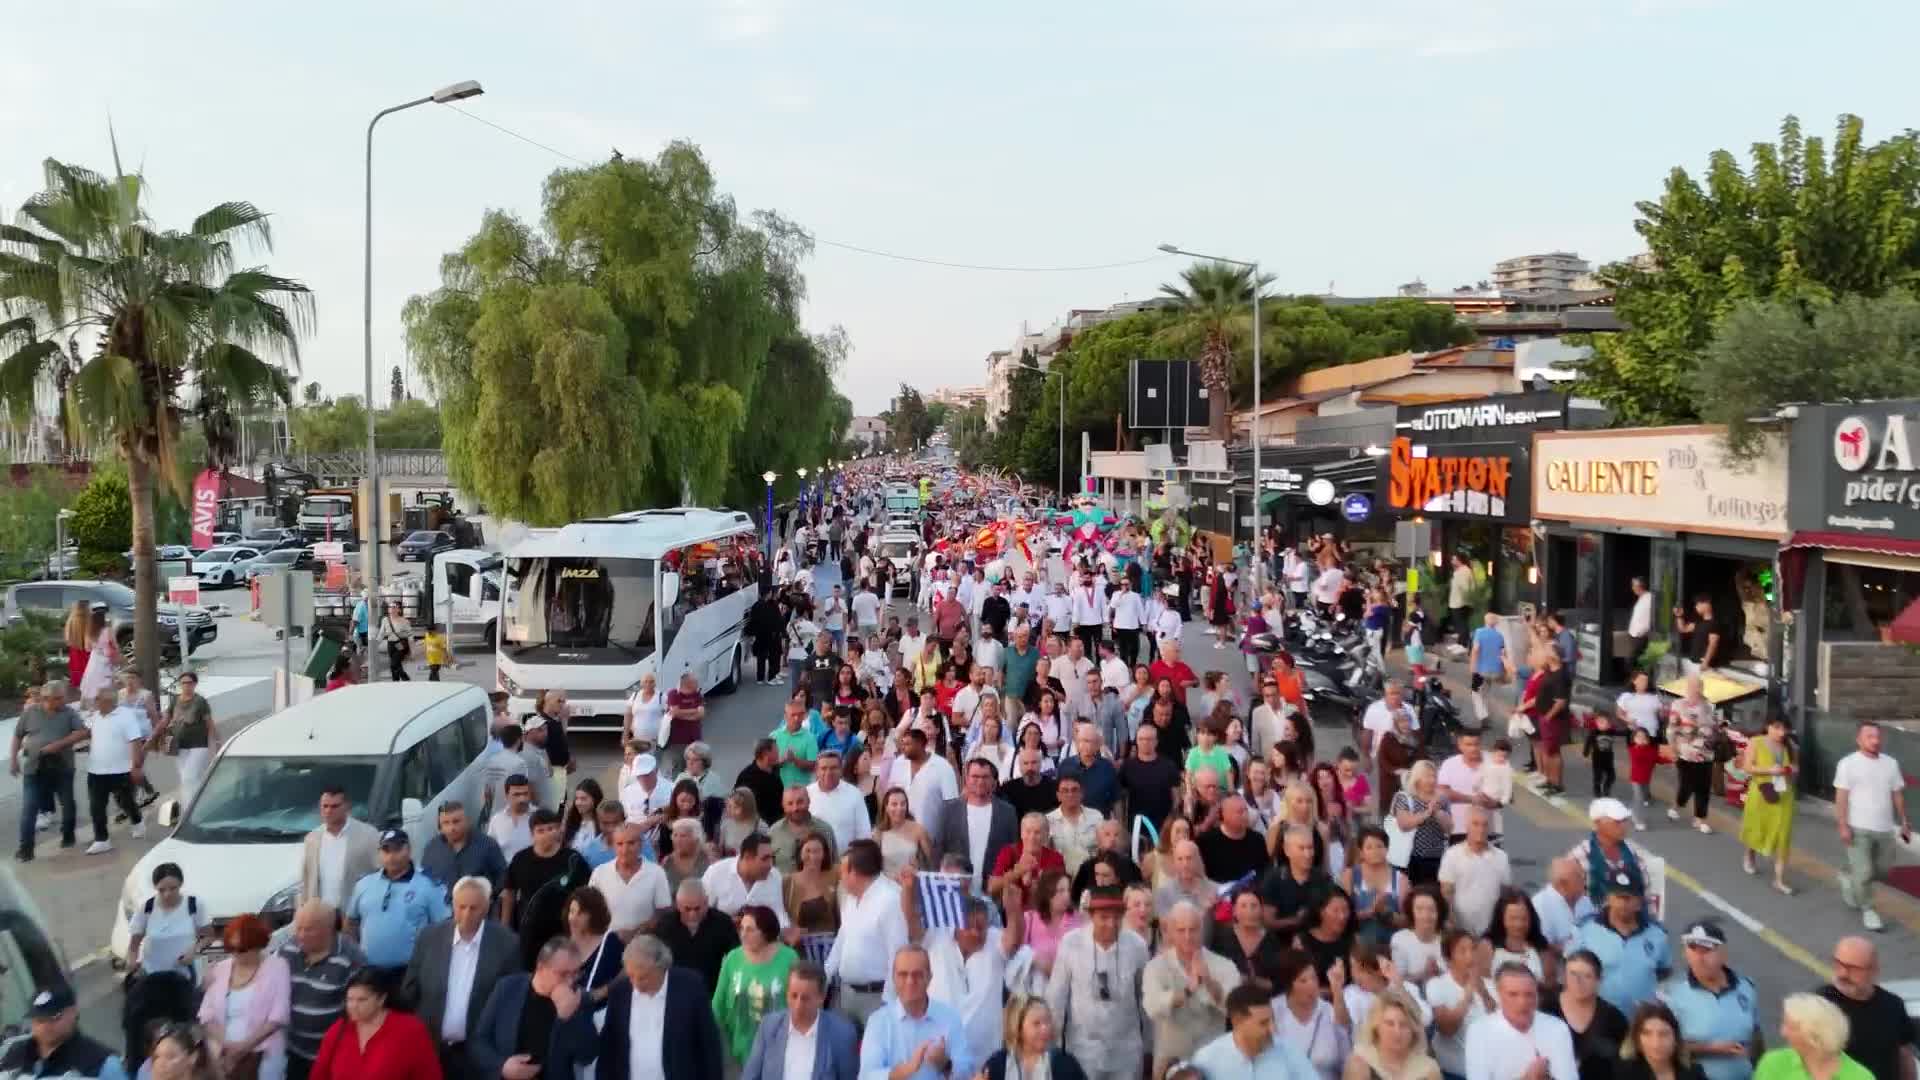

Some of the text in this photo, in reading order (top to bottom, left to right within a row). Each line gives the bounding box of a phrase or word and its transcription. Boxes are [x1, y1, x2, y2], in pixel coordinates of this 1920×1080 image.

[1874, 414, 1920, 471] A
[1389, 436, 1511, 510] STATION
[1546, 454, 1659, 496] CALIENTE
[194, 488, 216, 536] AVIS
